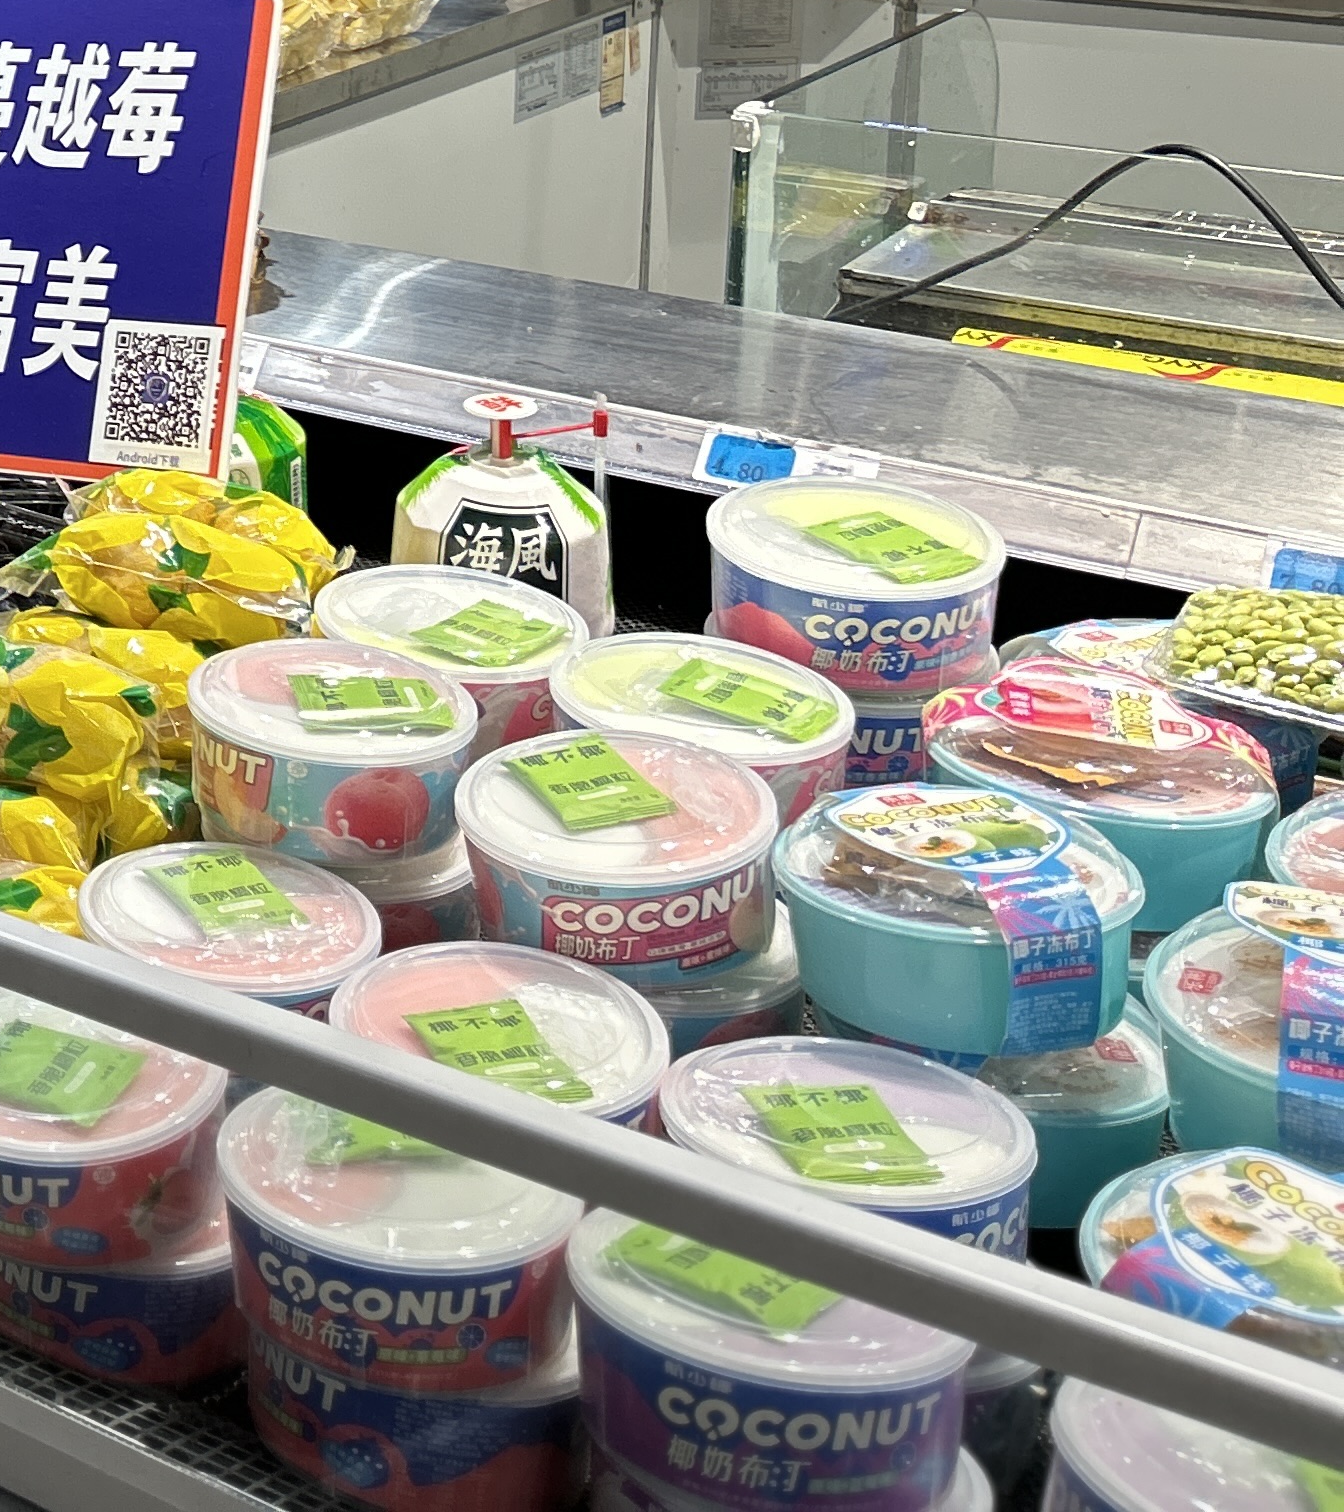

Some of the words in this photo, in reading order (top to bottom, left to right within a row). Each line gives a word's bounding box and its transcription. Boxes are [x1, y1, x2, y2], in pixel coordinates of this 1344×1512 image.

[804, 591, 992, 646] COCONUT
[839, 794, 1001, 829] COCONUT
[552, 864, 763, 935] COCONU
[258, 1250, 512, 1326] COCONUT
[657, 1385, 942, 1451] COCONUT
